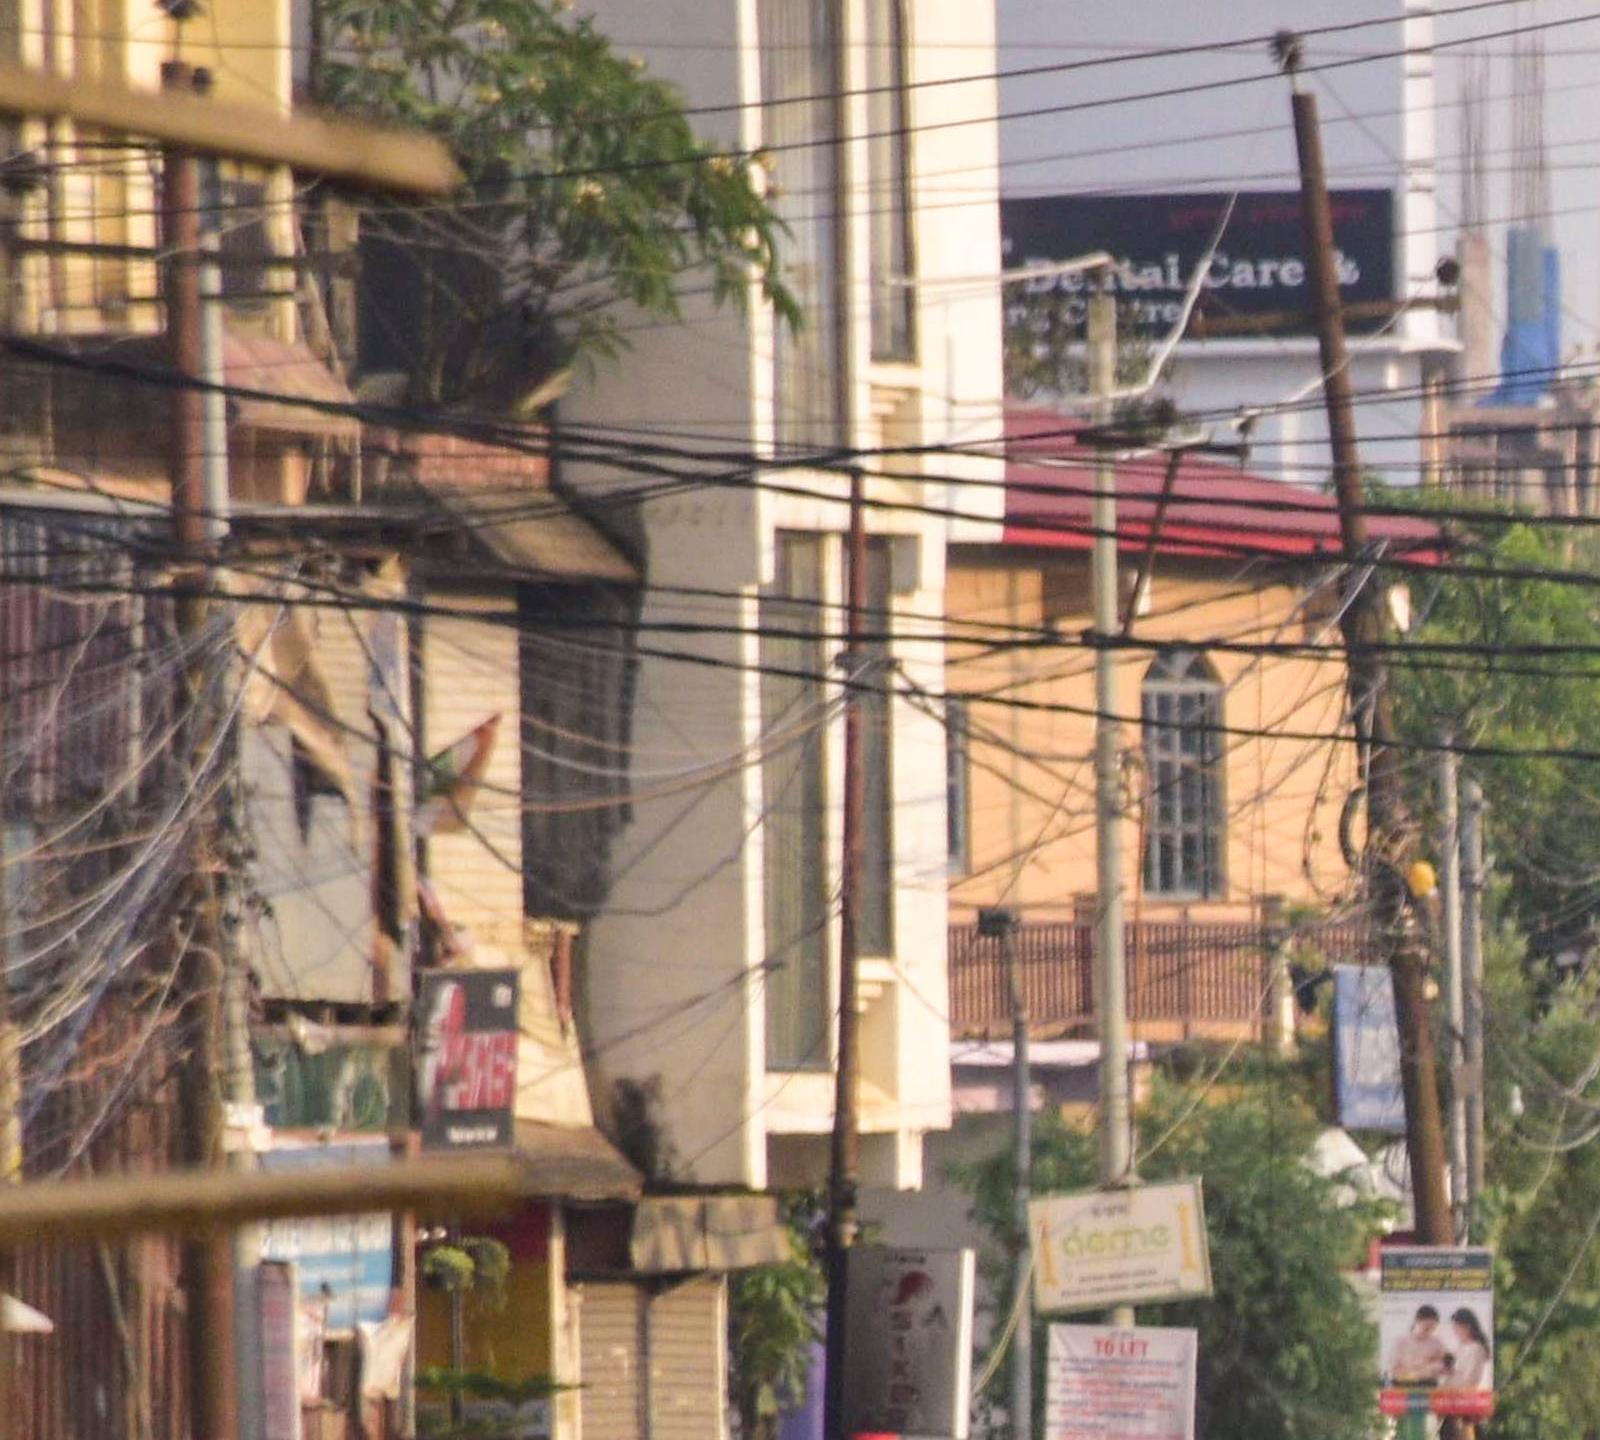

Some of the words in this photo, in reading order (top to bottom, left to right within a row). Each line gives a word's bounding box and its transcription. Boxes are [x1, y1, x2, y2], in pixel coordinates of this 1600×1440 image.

[1196, 252, 1306, 289] Care
[1093, 1337, 1115, 1356] TO
[1119, 1337, 1151, 1356] LET
